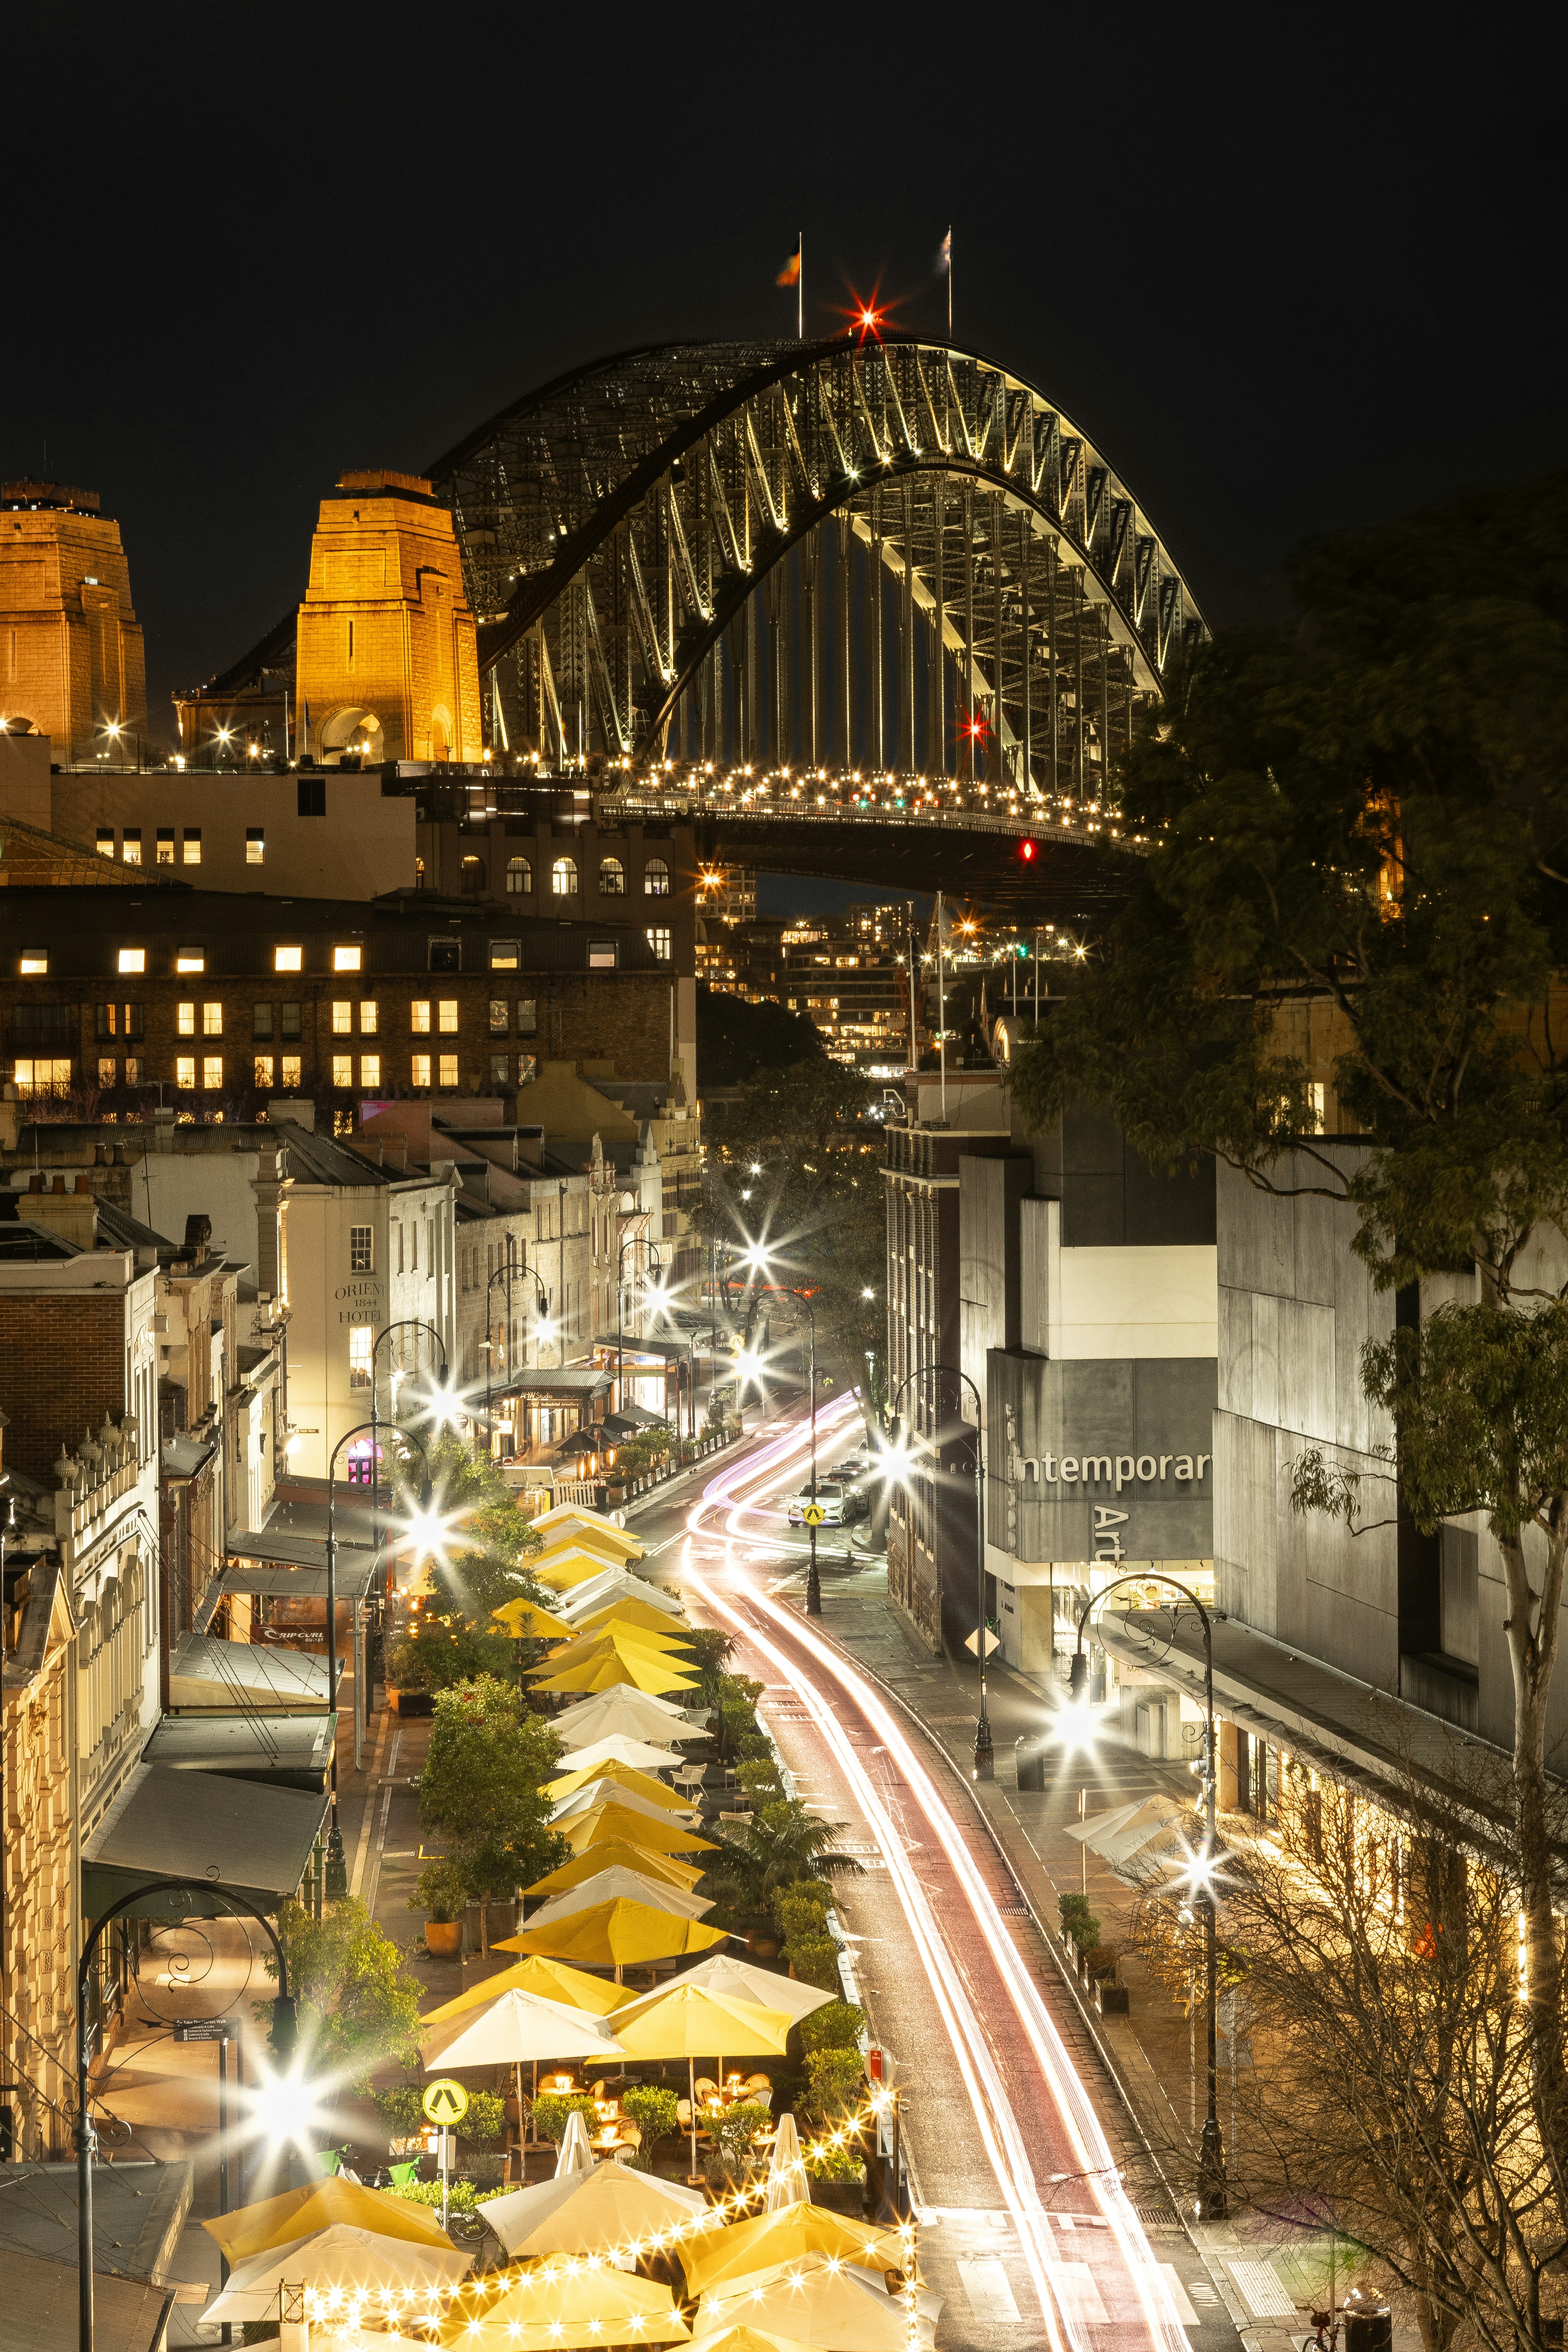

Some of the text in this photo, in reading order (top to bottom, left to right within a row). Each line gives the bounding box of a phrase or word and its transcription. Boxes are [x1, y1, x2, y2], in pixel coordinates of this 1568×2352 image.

[335, 1283, 385, 1300] ORIENT
[353, 1298, 378, 1307] 1844
[339, 1310, 383, 1323] HOTEL
[1013, 1451, 1213, 1492] ntemporar
[1093, 1504, 1130, 1561] Art
